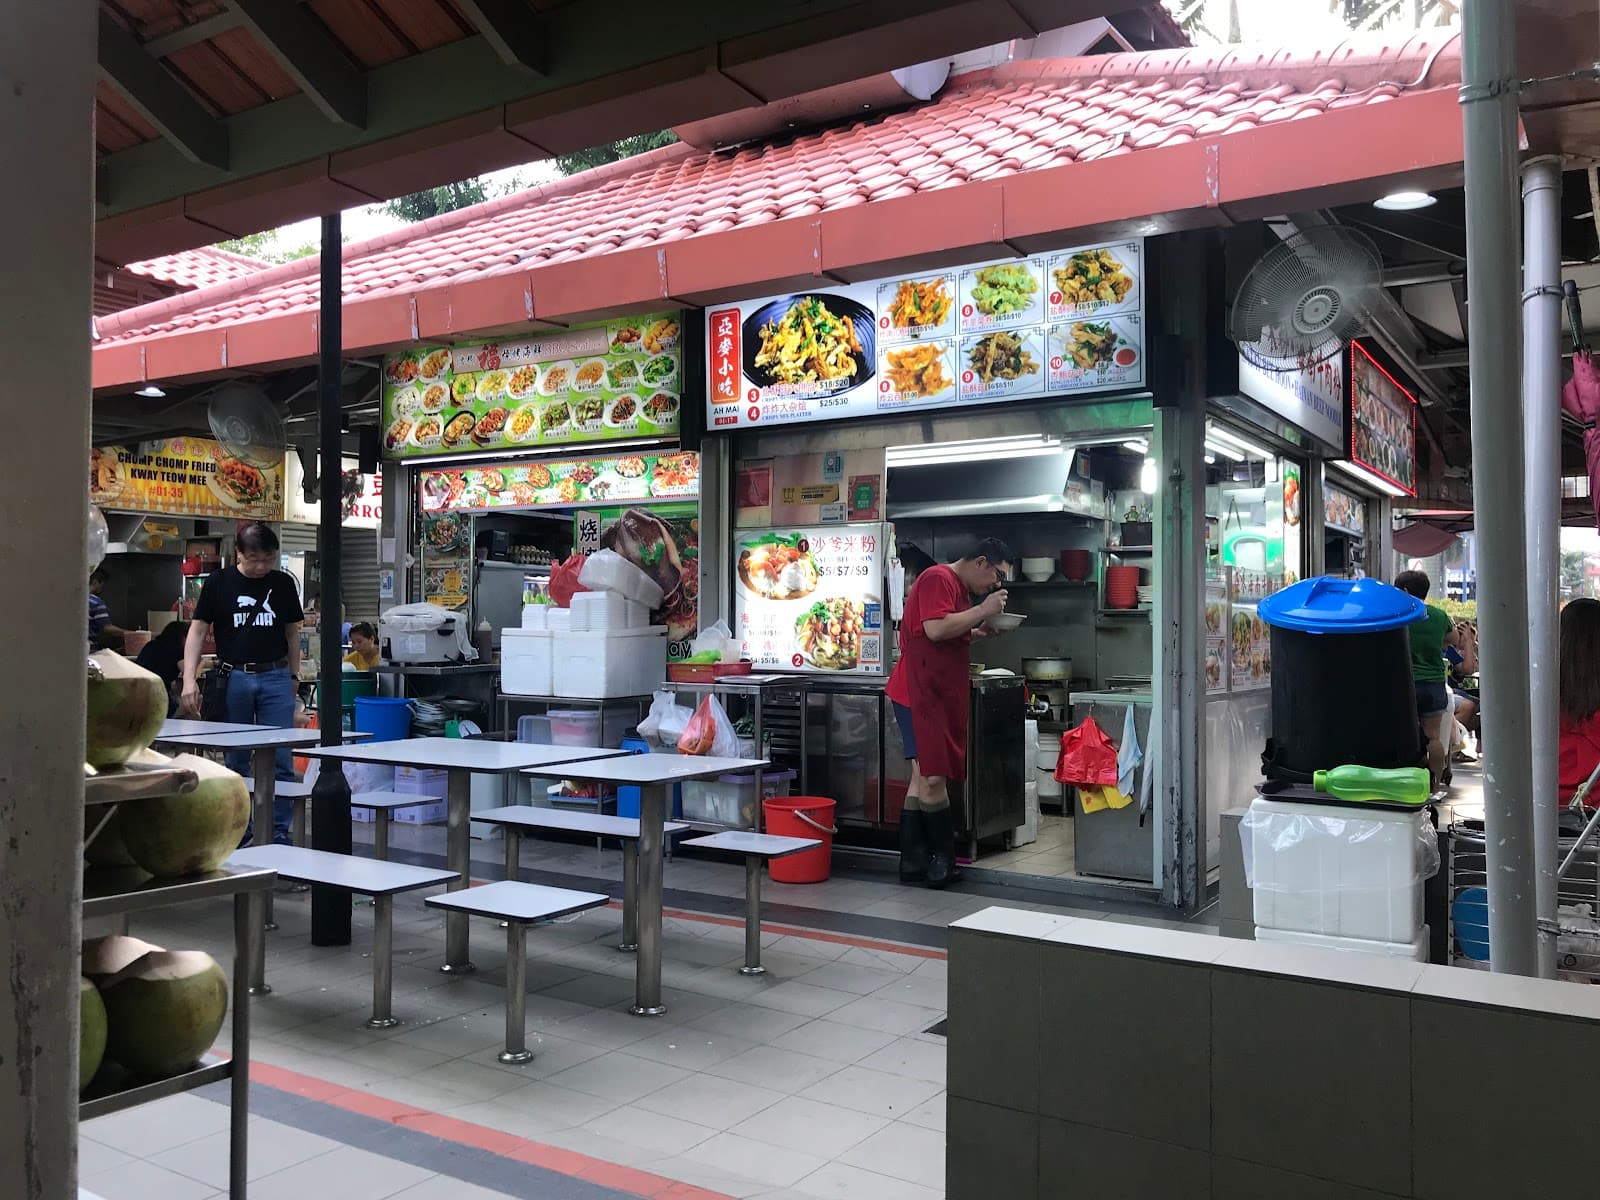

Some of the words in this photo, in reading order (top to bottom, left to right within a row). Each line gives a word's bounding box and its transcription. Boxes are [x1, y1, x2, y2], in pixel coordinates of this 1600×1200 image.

[713, 407, 724, 415] AH
[725, 405, 739, 414] MAI
[155, 456, 190, 470] CHOMP
[191, 460, 217, 473] FRIED
[130, 468, 158, 480] KWAY
[161, 471, 188, 484] TEOW
[189, 473, 208, 486] MEE
[149, 485, 184, 498] #01-35
[668, 641, 692, 659] ay
